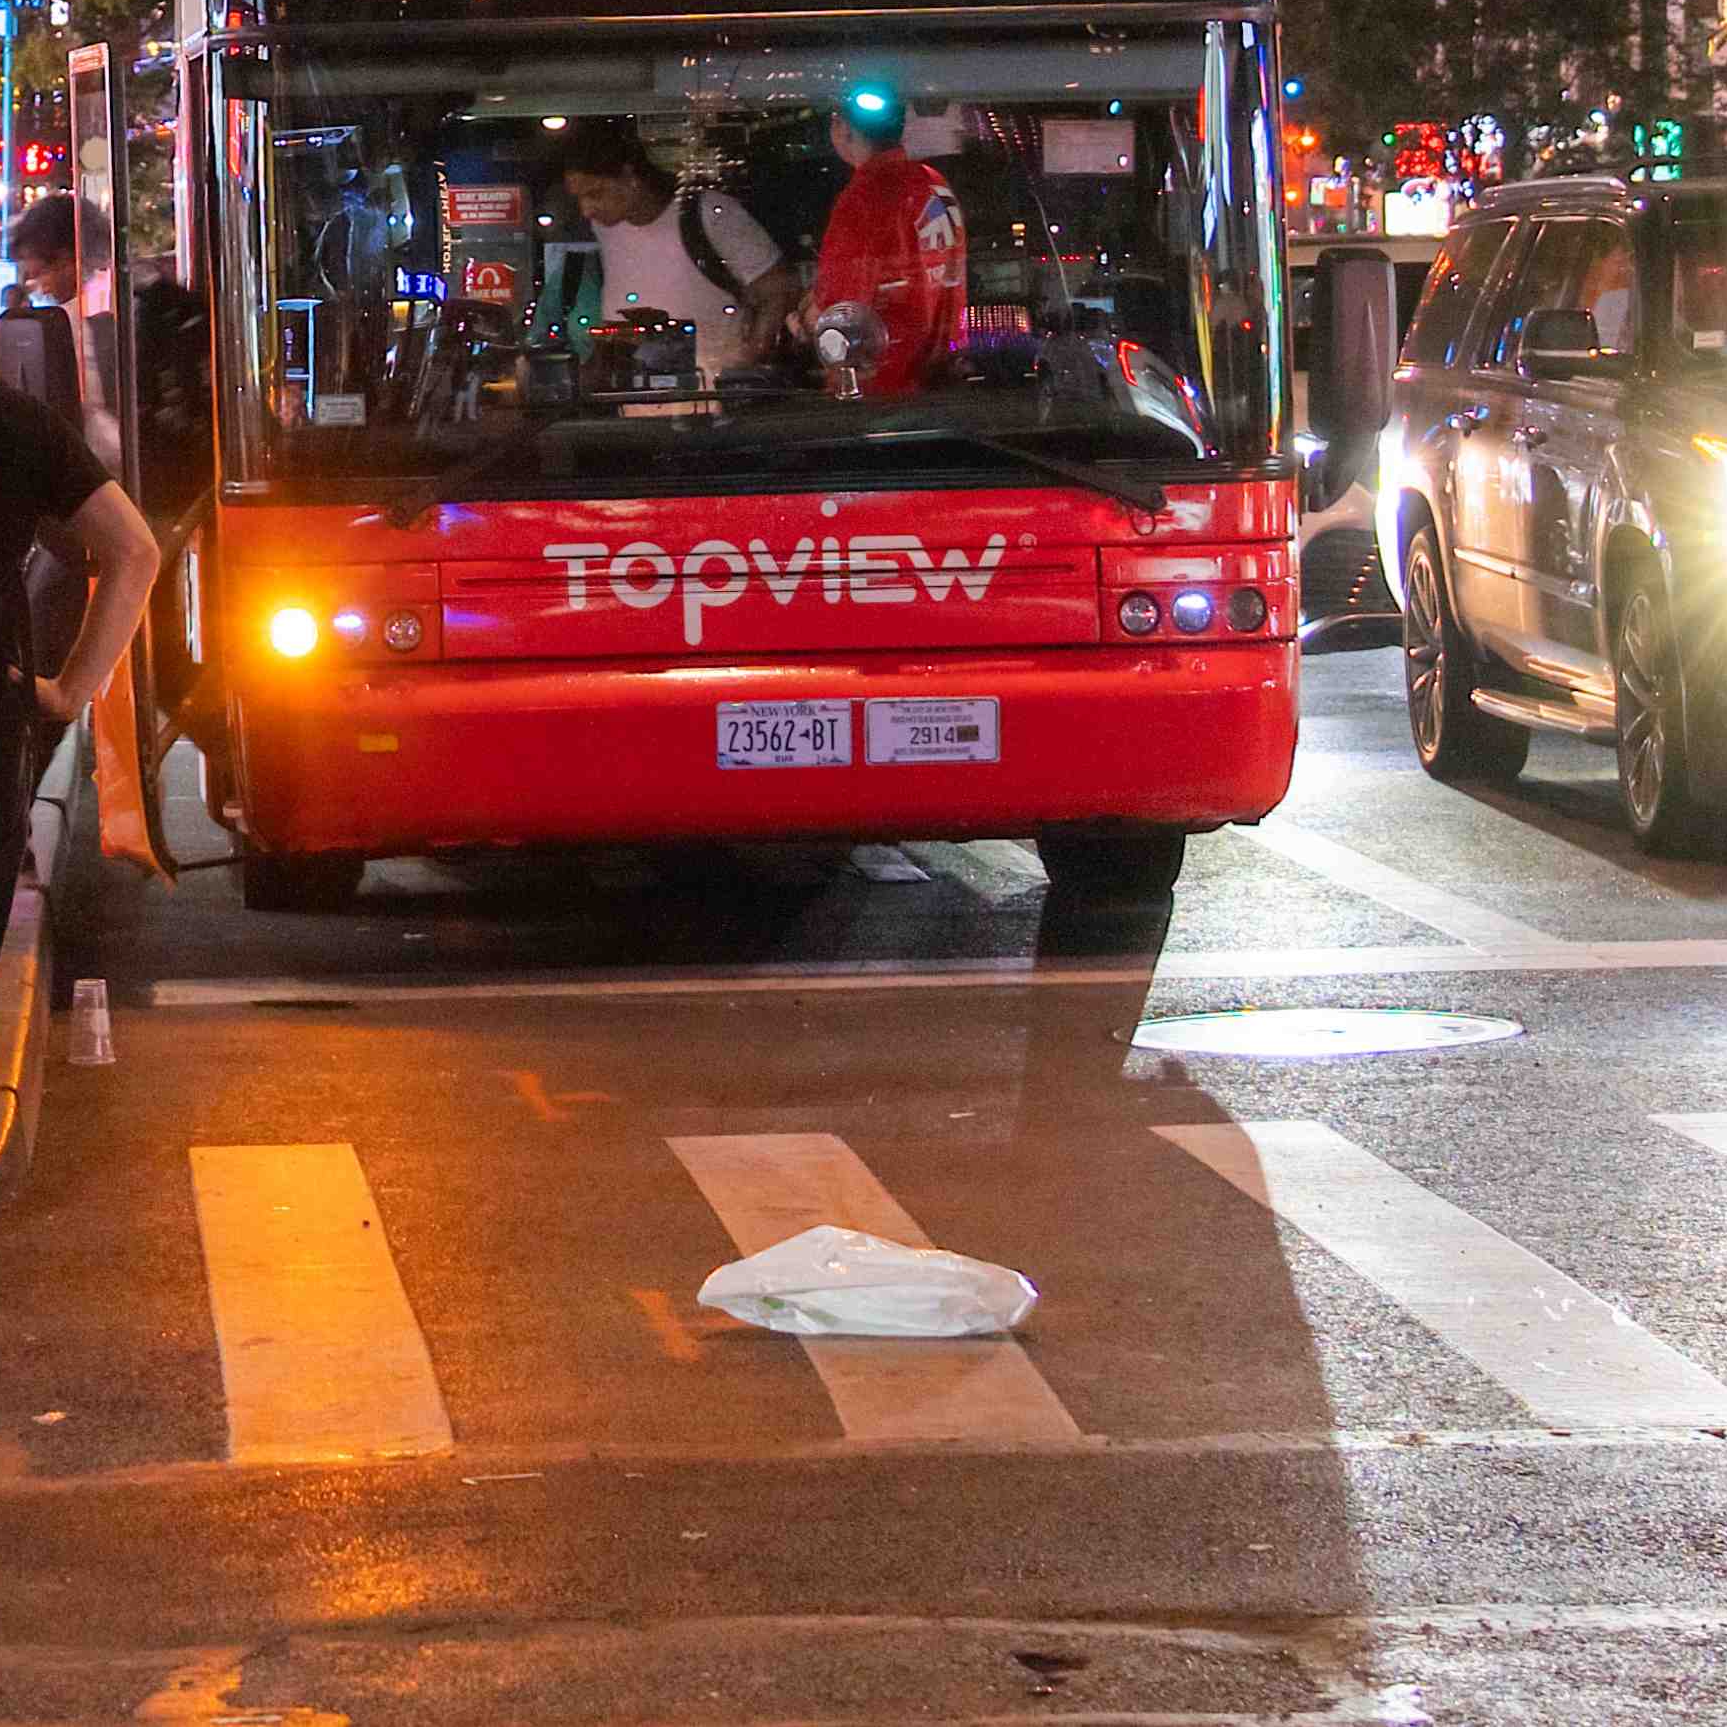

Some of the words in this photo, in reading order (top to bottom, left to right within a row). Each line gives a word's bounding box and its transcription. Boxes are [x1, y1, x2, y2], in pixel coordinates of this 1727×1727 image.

[751, 705, 782, 717] NEW
[783, 704, 817, 716] YORK
[910, 726, 955, 745] 2914
